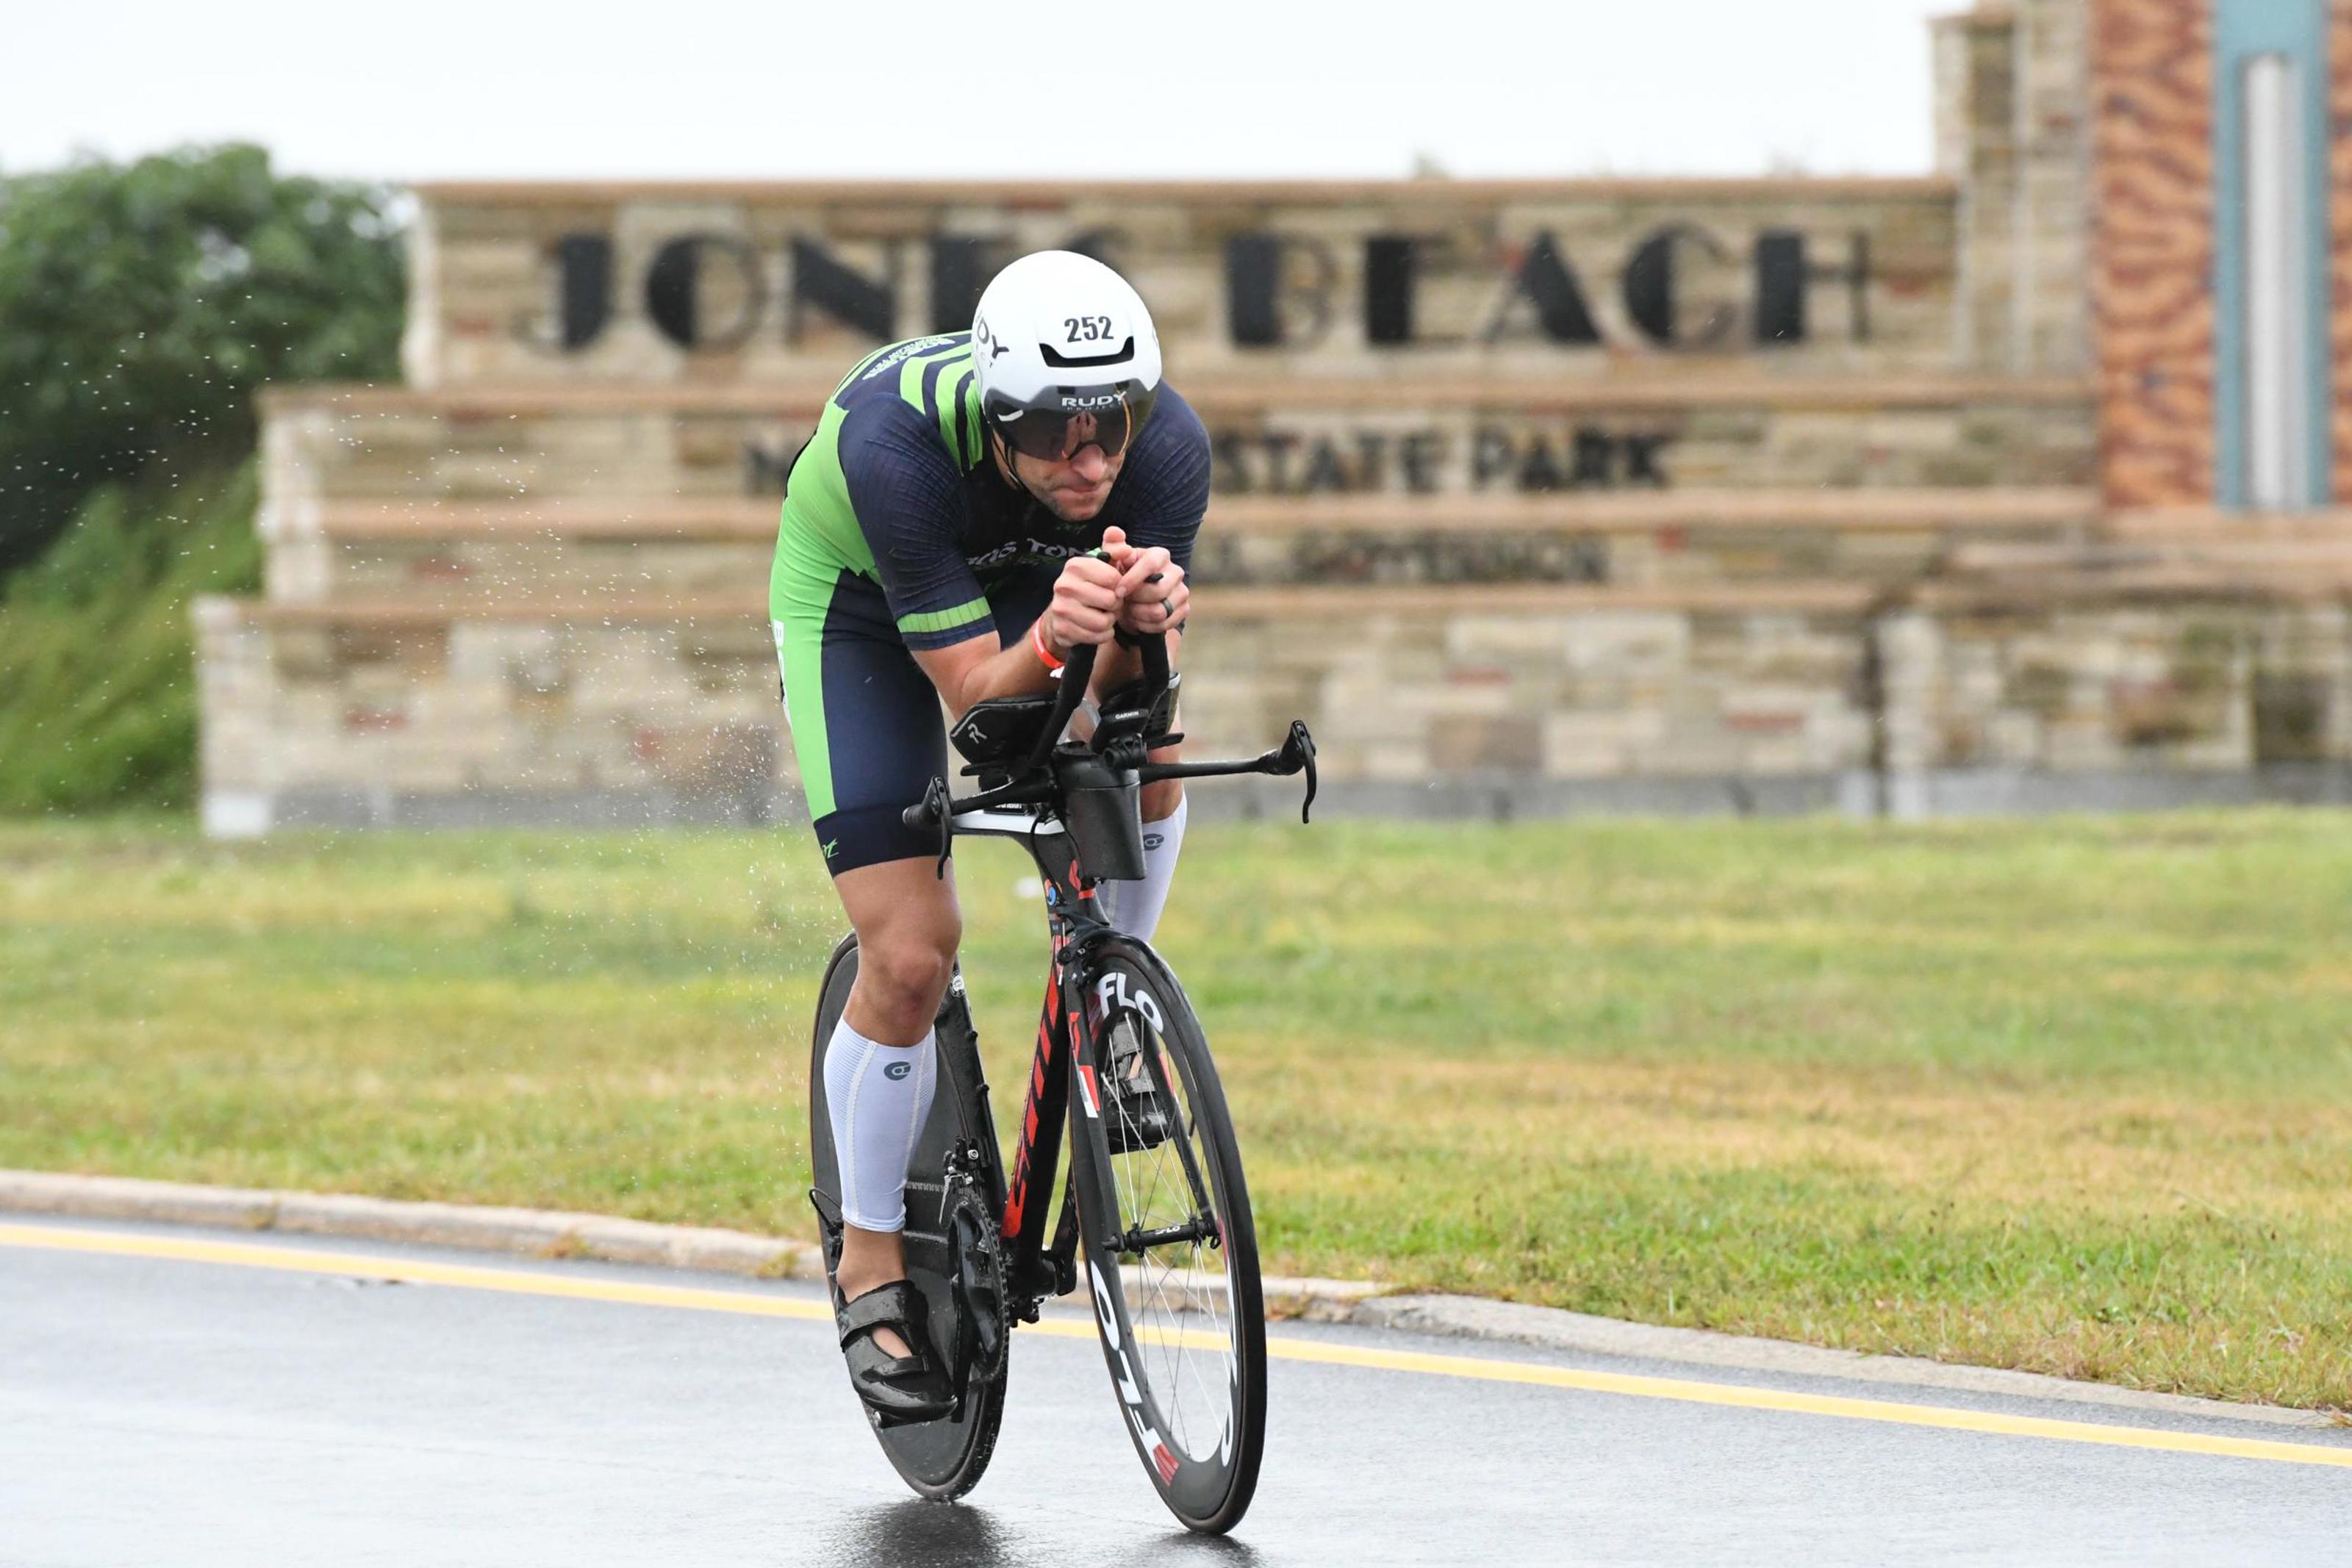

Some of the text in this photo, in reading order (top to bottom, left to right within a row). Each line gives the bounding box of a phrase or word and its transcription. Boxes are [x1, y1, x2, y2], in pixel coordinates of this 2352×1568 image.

[1226, 225, 1871, 350] BEACH
[1064, 316, 1114, 342] 252
[1061, 391, 1126, 406] RUDY
[1472, 426, 1672, 494] PARK
[1115, 711, 1139, 719] GARMIN
[1098, 972, 1164, 1033] FLO
